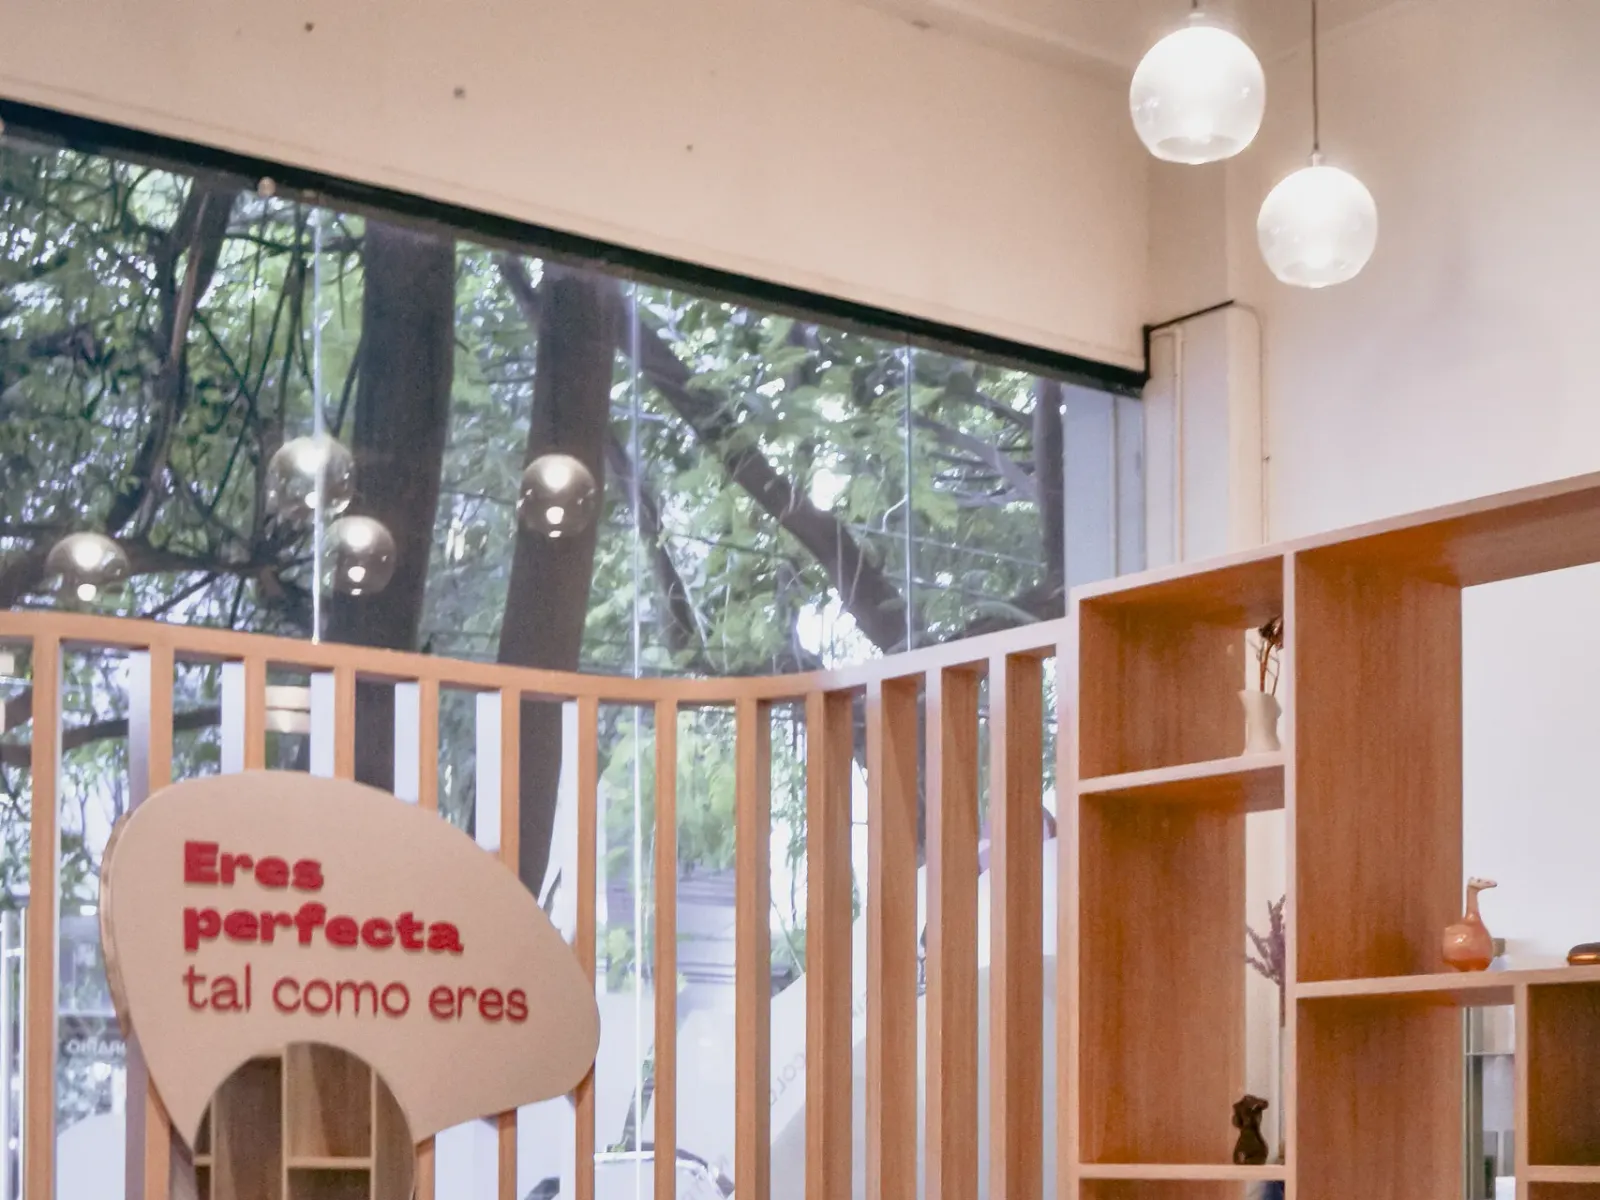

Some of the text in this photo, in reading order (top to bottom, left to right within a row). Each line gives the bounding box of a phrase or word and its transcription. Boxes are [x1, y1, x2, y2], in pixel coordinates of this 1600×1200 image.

[183, 839, 324, 892] Eres
[183, 902, 464, 955] perfecta
[183, 963, 529, 1023] tal como eres
